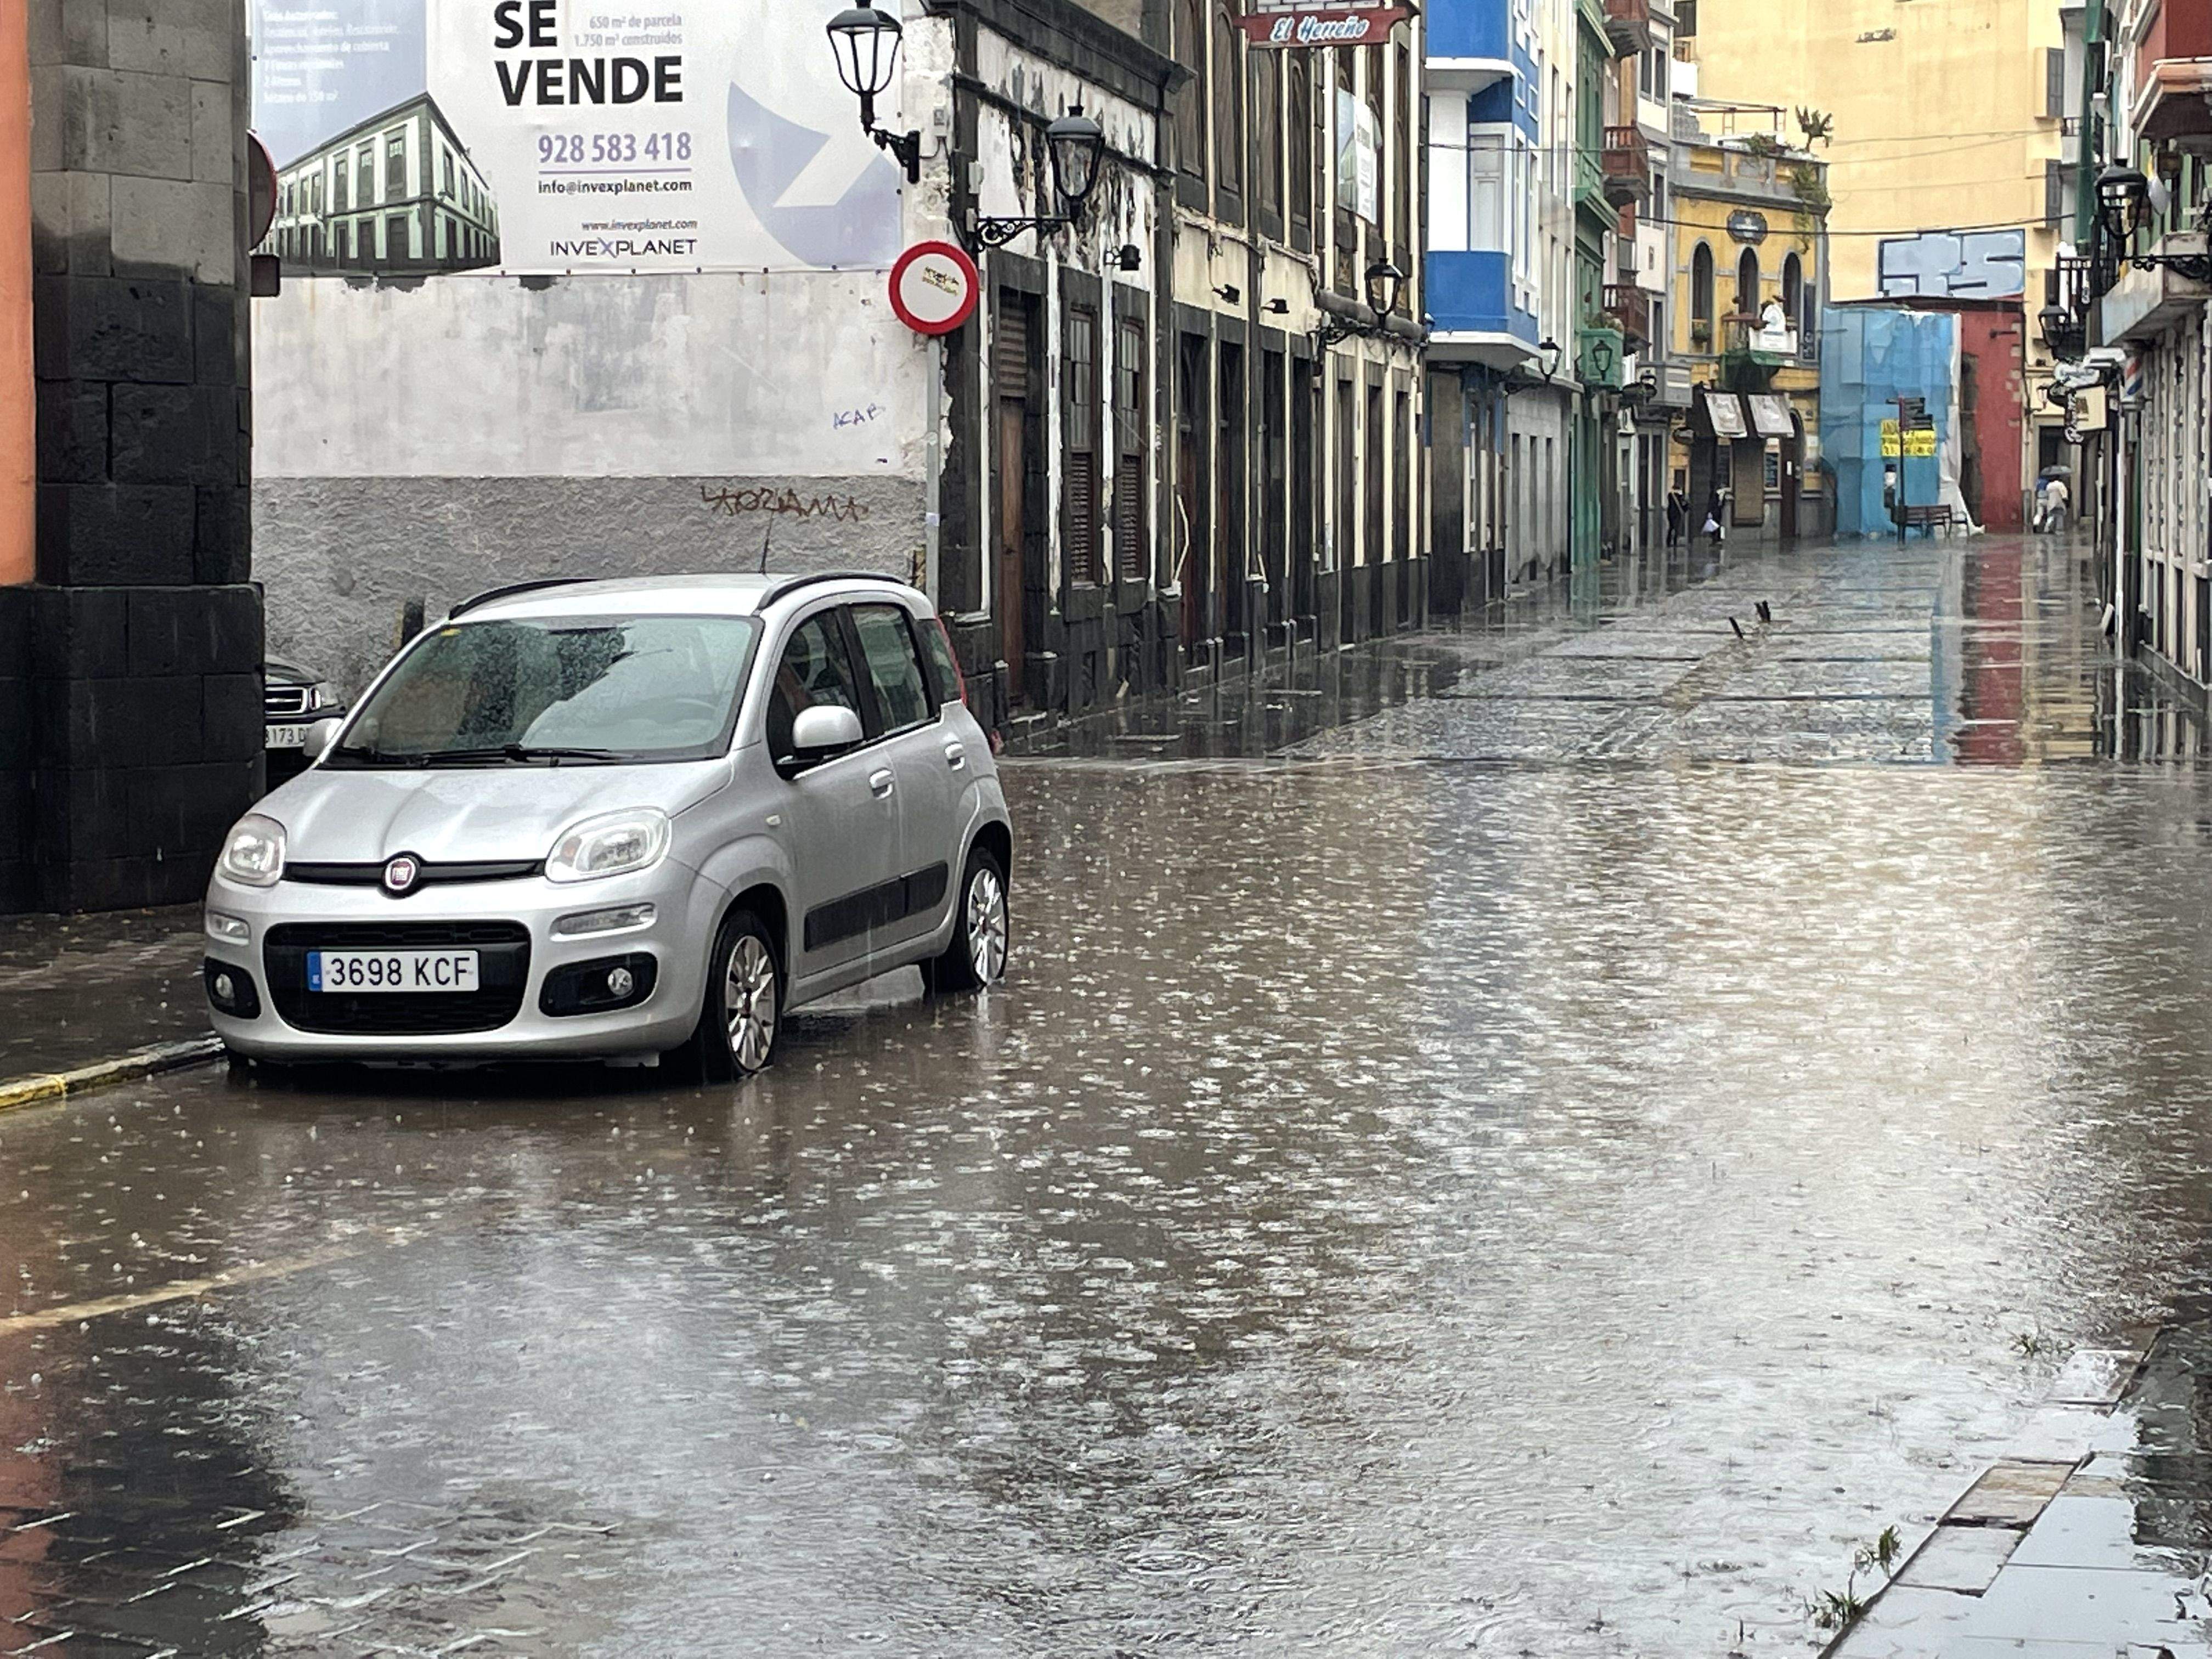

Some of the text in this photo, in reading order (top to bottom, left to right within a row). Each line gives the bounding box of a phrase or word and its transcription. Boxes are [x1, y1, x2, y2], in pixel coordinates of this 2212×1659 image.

[494, 1, 557, 48] SE
[589, 16, 610, 29] 650
[629, 15, 641, 27] de
[644, 14, 681, 30] parcela
[1270, 15, 1369, 43] El Herreño
[574, 33, 603, 47] 1.750
[622, 31, 682, 46] construidos
[494, 55, 683, 106] VENDE
[538, 132, 691, 163] 928 583 418
[538, 179, 692, 195] info@invexplanet.com
[582, 219, 697, 232] www.invexplanet.com
[550, 237, 697, 258] INVEXPLANET
[330, 957, 470, 986] 3698 KCF
